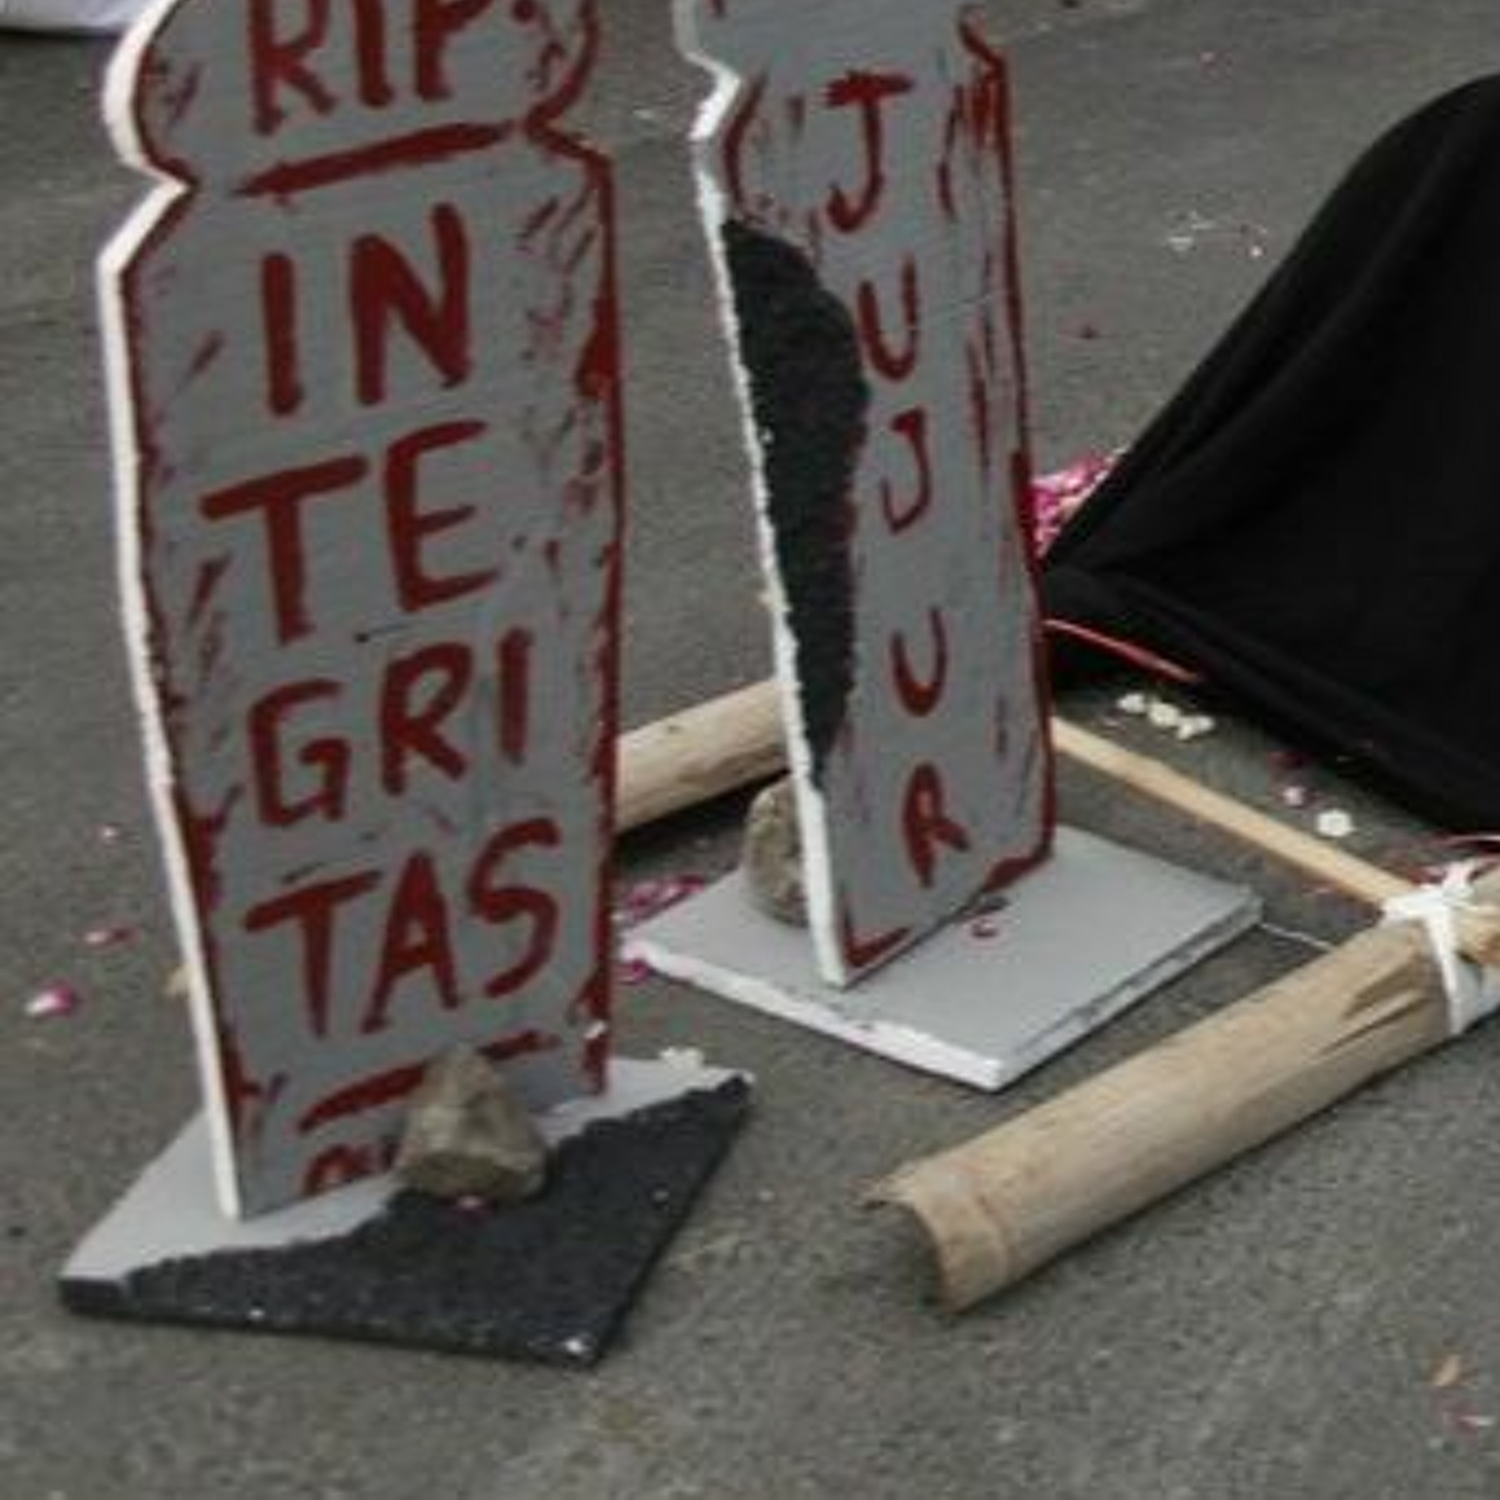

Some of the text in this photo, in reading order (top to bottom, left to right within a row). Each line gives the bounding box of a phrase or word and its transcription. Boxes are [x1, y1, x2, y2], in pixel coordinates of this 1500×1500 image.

[261, 204, 472, 416] IN
[200, 419, 500, 645] TE
[249, 627, 533, 827] GRI
[244, 816, 562, 1039] TAS
